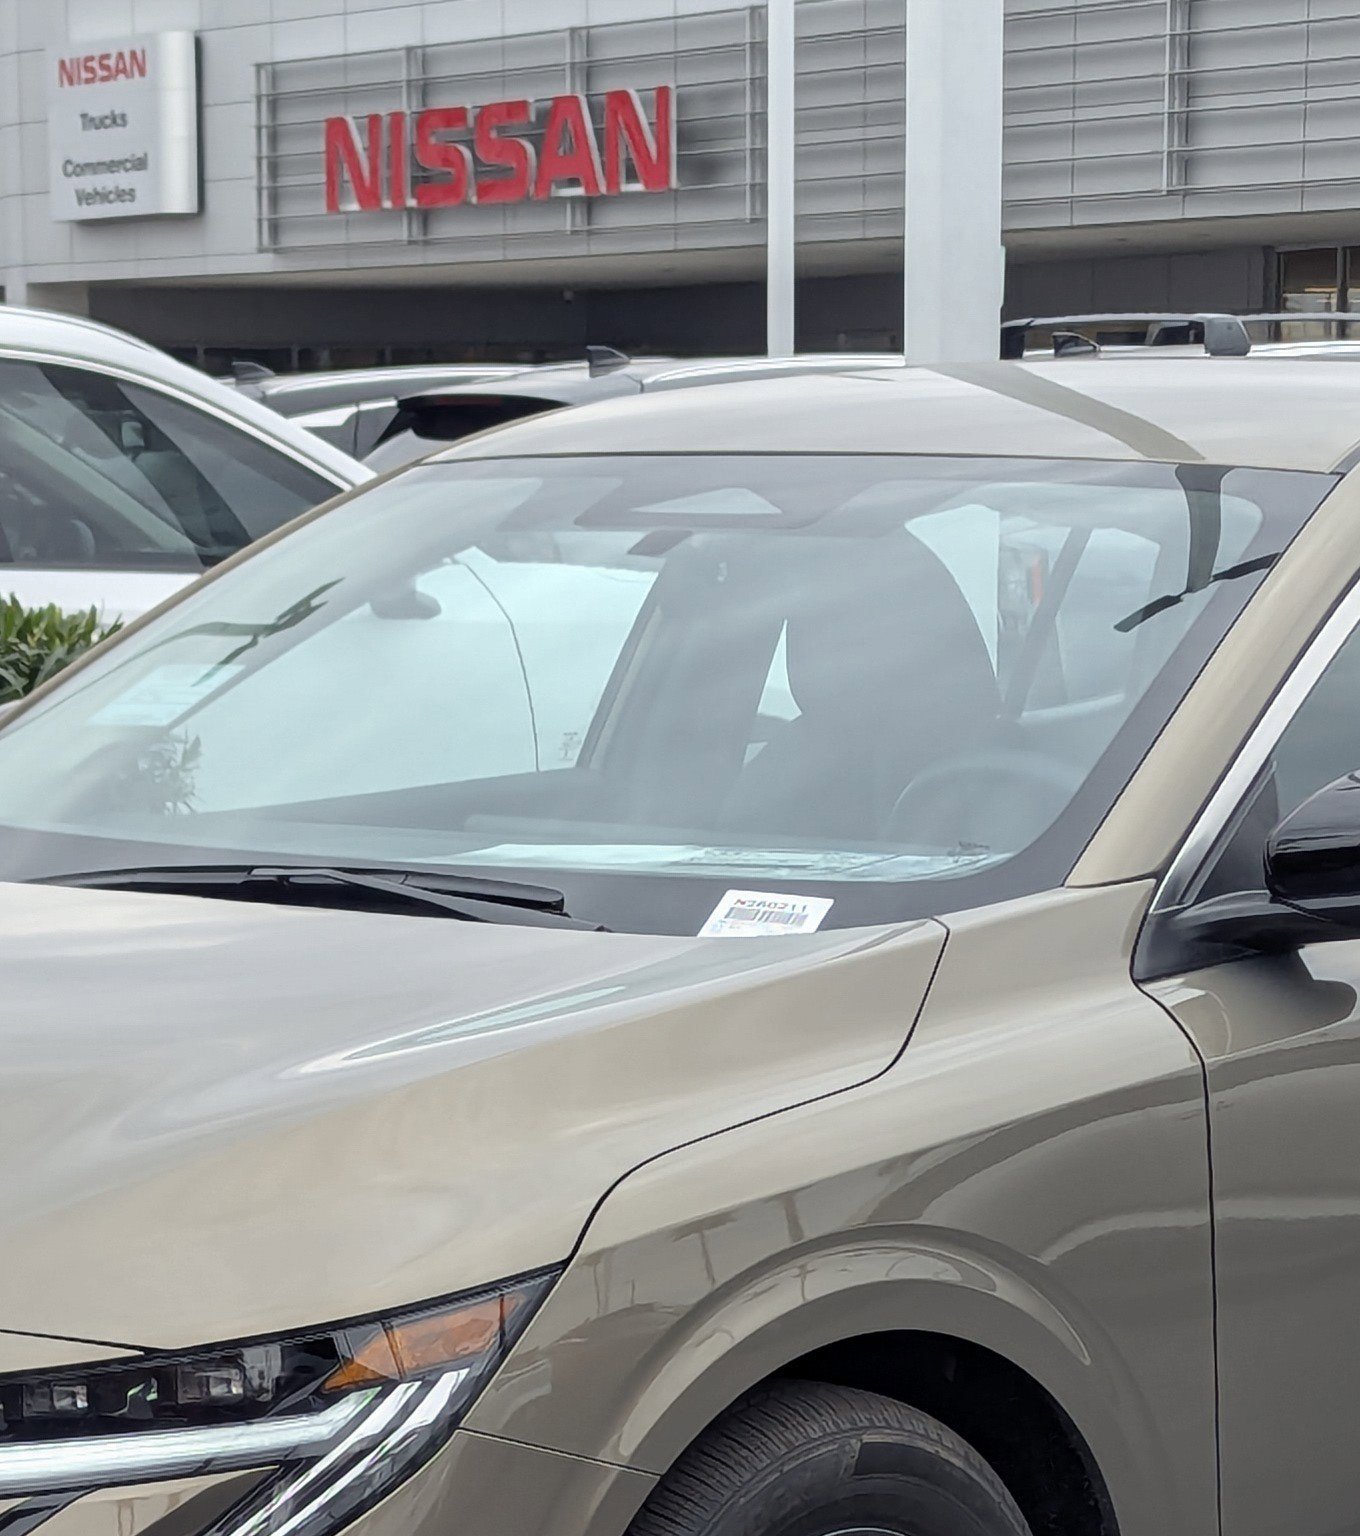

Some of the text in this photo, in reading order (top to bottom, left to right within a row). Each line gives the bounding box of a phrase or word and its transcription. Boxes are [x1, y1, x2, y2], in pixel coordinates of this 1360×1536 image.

[58, 47, 147, 87] NISSAN
[79, 110, 128, 131] Trucks
[324, 85, 674, 213] NISSAN
[61, 152, 148, 178] Commercial
[74, 186, 136, 206] Vehicles
